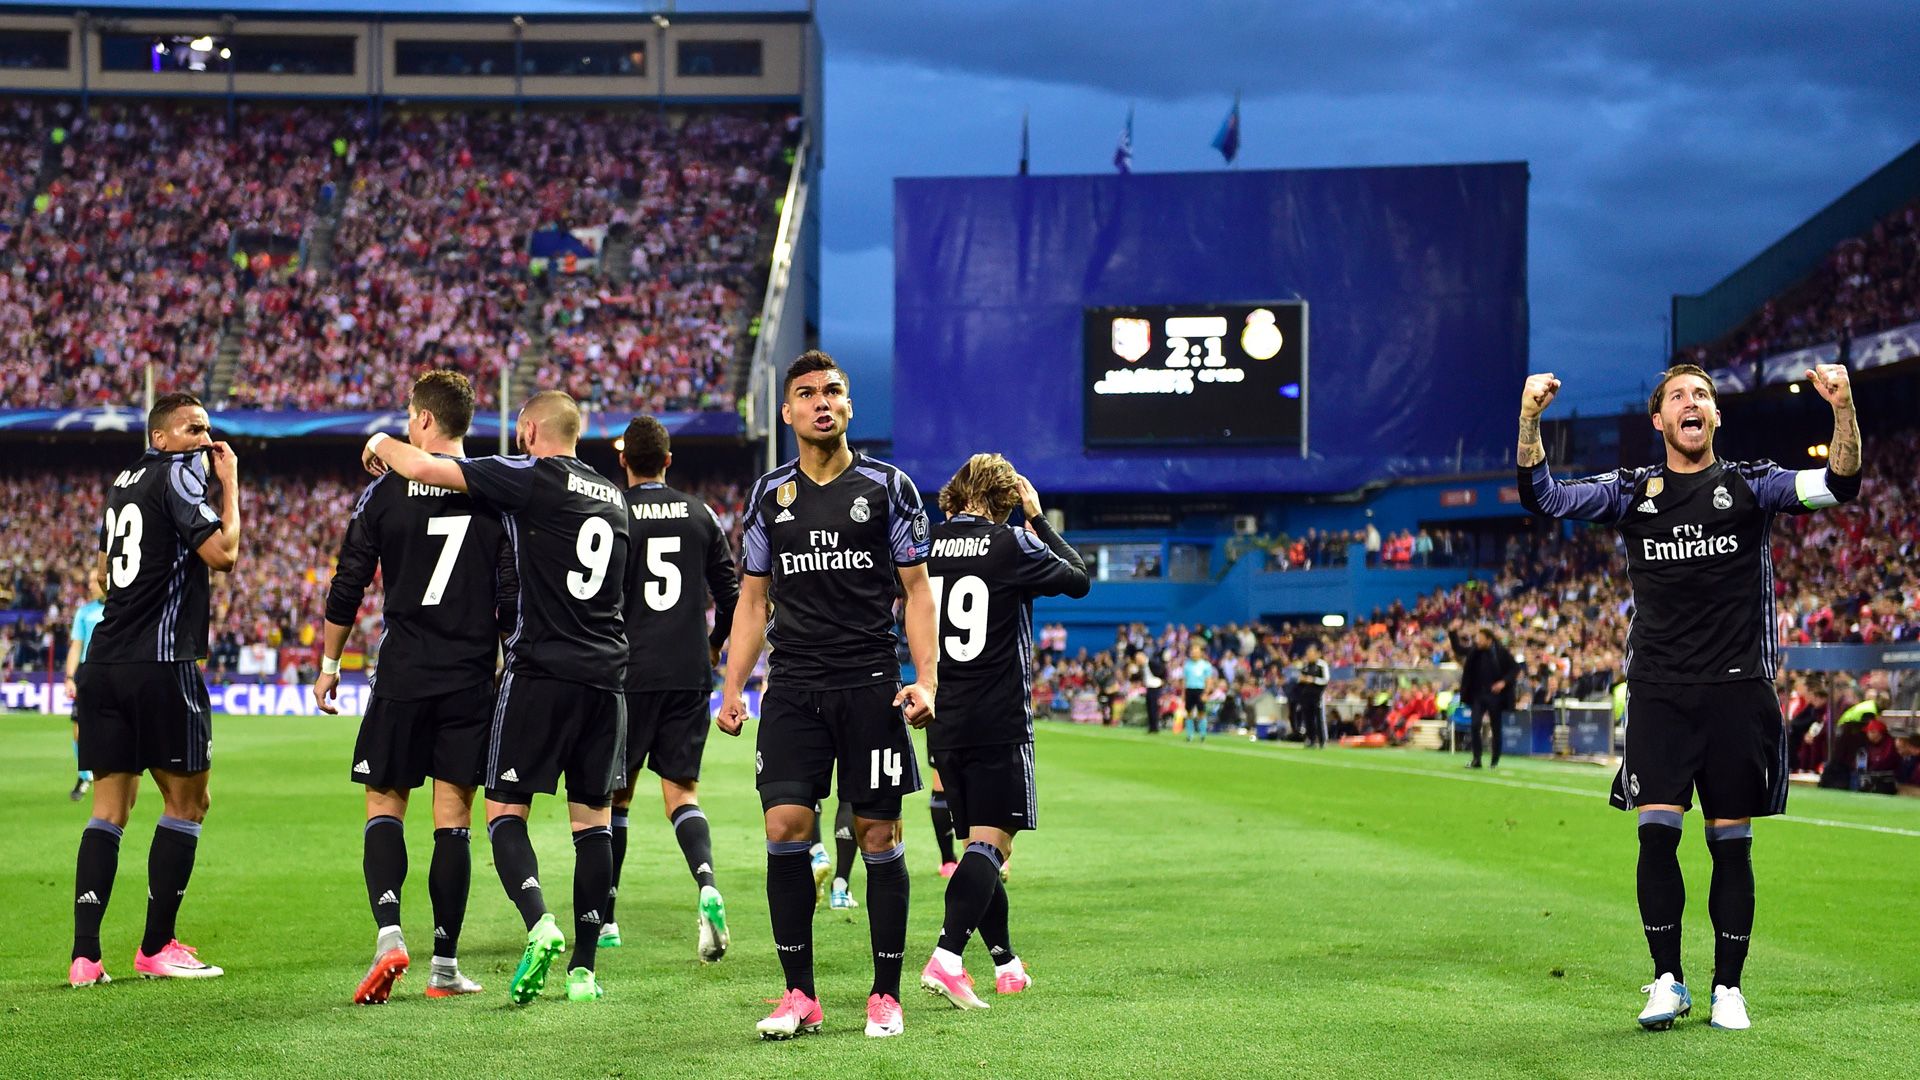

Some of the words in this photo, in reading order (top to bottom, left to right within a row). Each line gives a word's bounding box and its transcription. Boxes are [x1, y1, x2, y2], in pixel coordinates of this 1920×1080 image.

[1165, 337, 1227, 368] 2:1
[567, 472, 623, 509] BENZEMA
[631, 501, 690, 520] VARANE
[809, 529, 839, 549] Fly
[1672, 523, 1703, 539] Fly
[421, 515, 472, 606] 7
[566, 516, 615, 601] 9
[779, 547, 874, 576] Emirates
[1642, 535, 1739, 561] Emirates
[644, 536, 682, 612] 5
[1, 682, 75, 716] THE
[870, 747, 903, 790] 14
